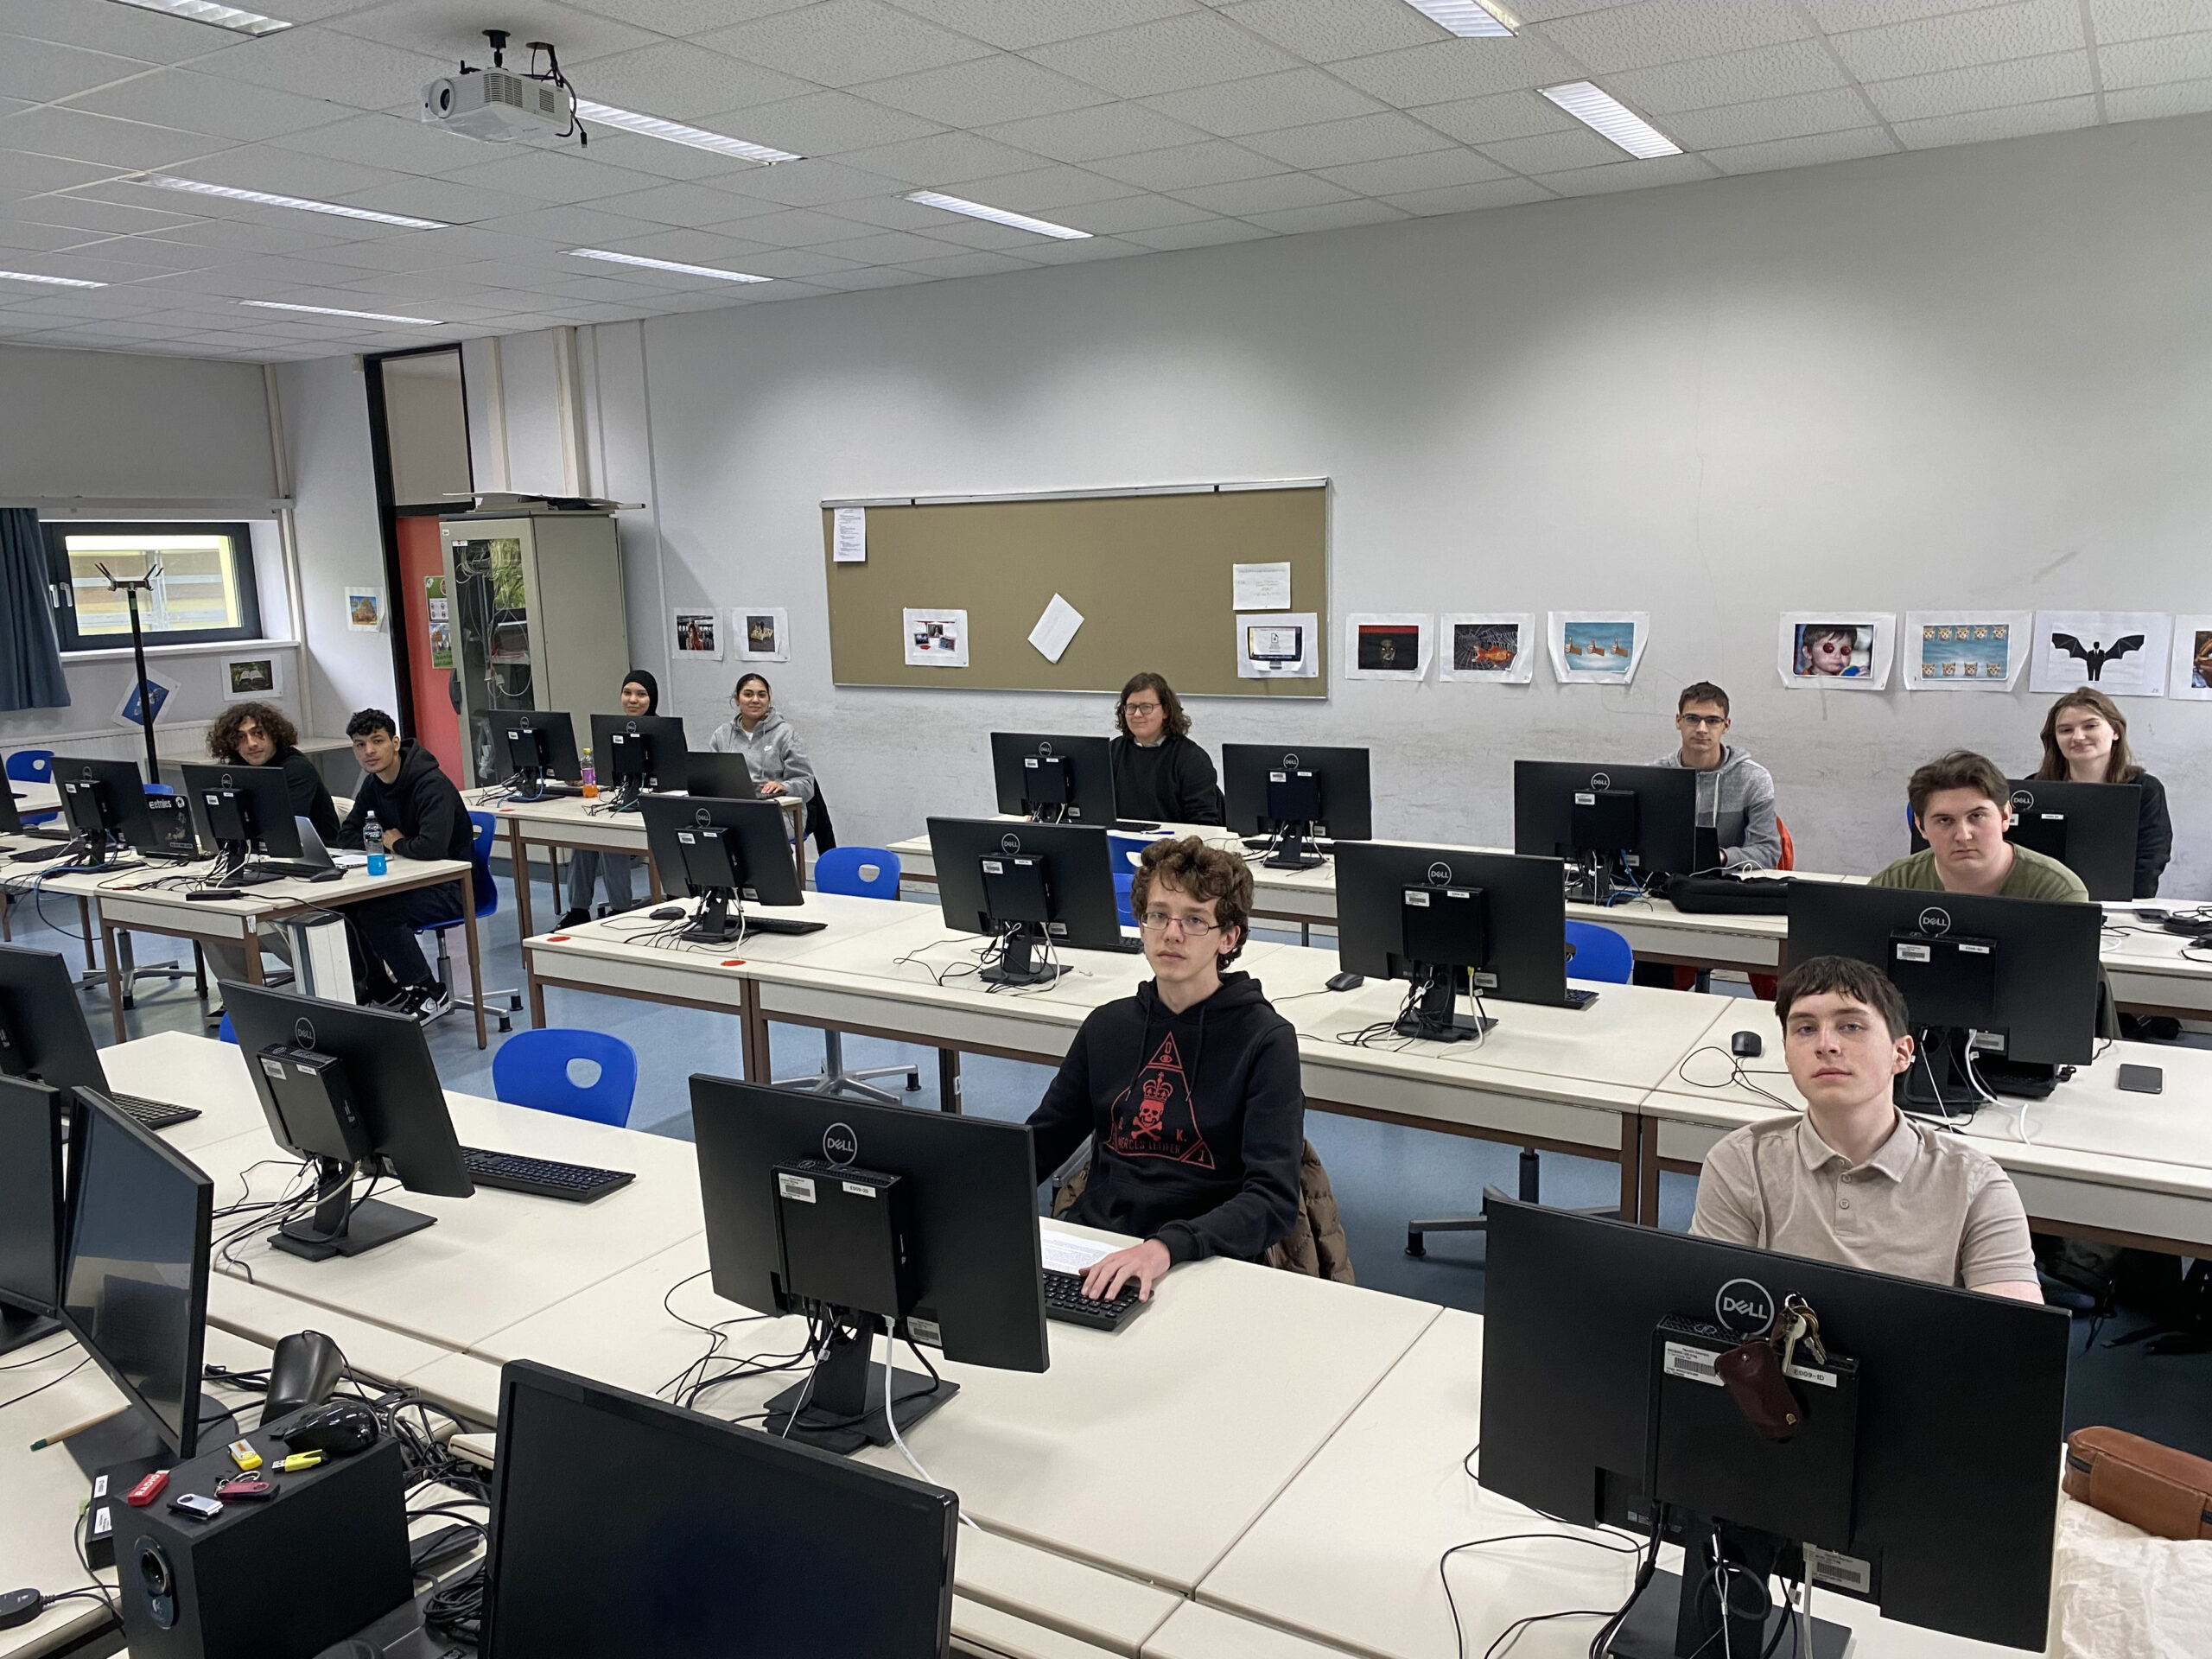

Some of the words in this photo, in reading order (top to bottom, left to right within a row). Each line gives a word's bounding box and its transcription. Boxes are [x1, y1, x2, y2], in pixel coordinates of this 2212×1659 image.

[1430, 870, 1449, 879] DELL
[1923, 916, 1948, 927] DELL
[297, 1028, 315, 1039] DELL
[827, 1137, 855, 1152] DELL
[1722, 1296, 1768, 1319] DELL
[134, 1473, 161, 1497] RADIO
